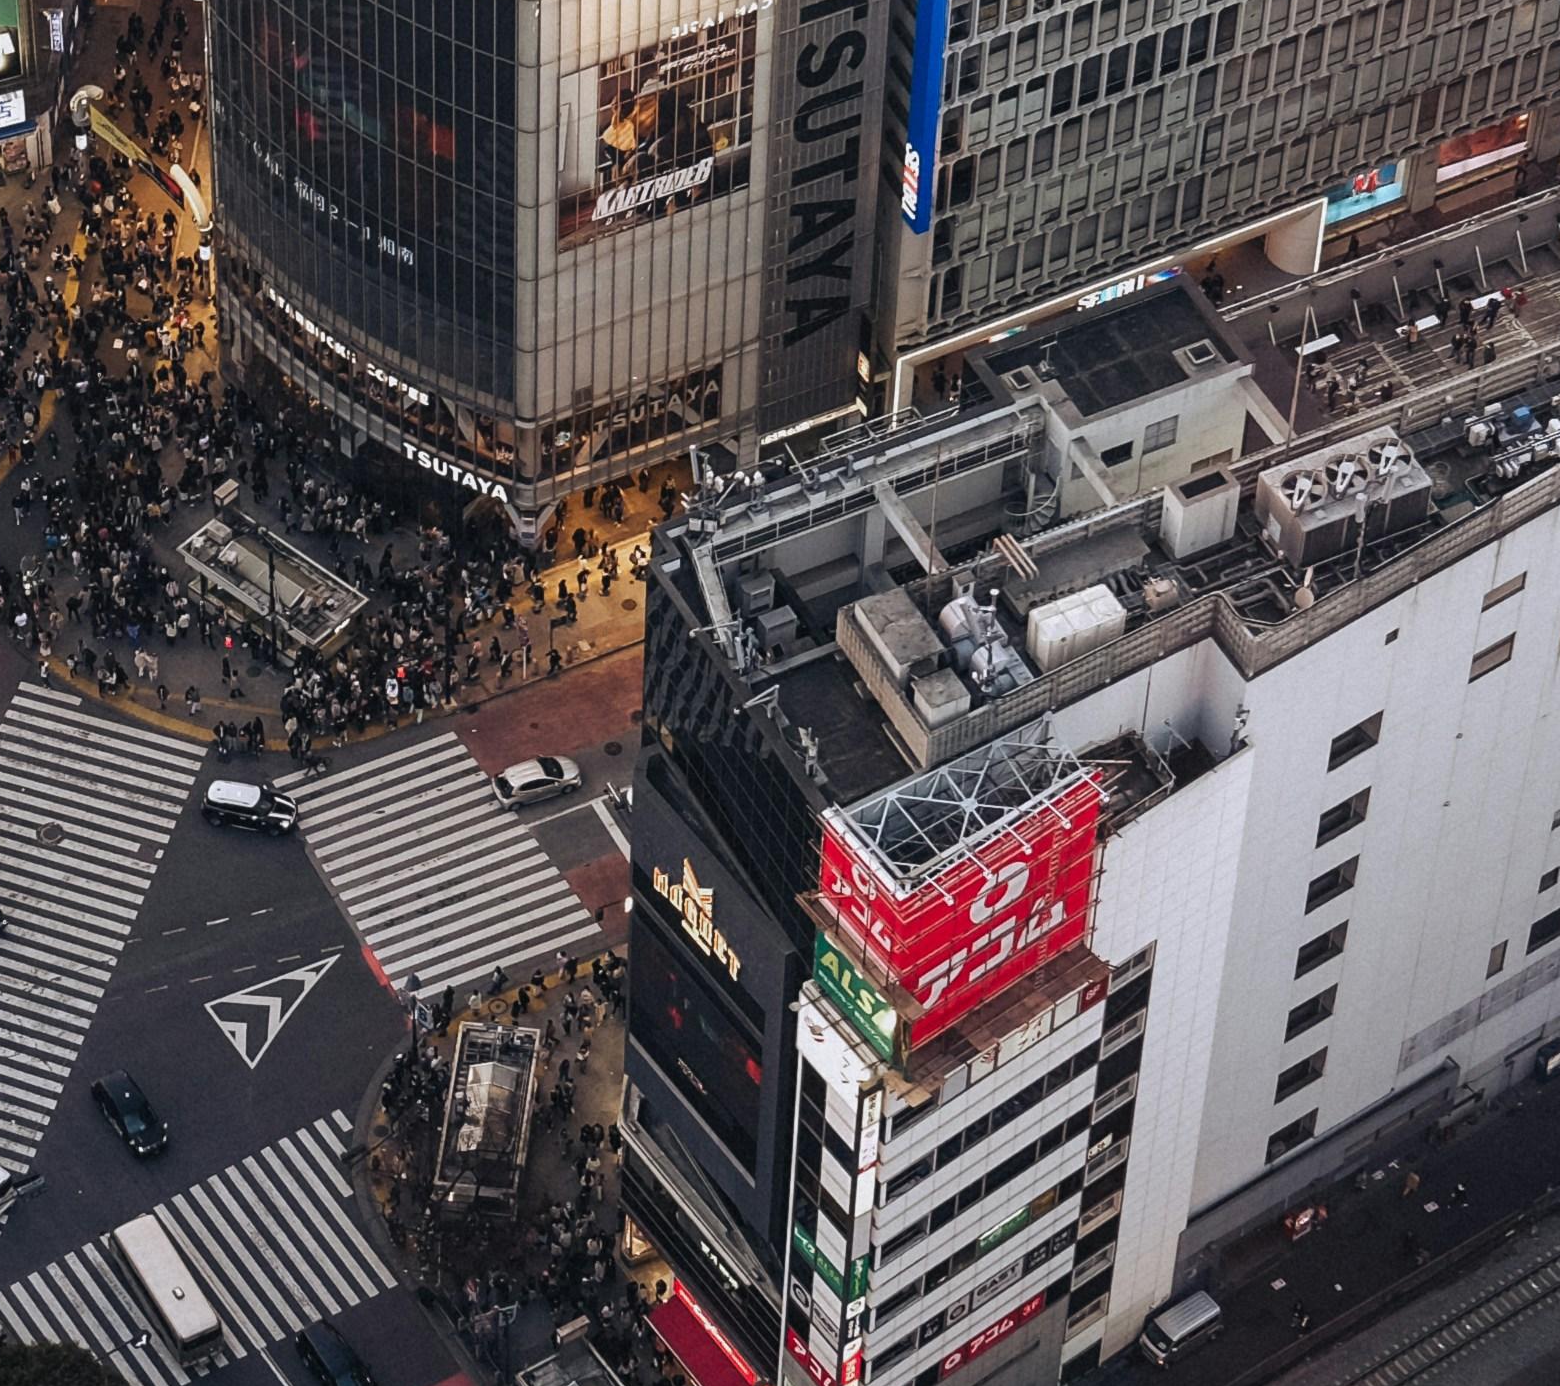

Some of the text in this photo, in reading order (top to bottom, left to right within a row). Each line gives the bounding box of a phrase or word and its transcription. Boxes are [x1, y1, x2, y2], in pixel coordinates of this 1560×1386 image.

[591, 156, 715, 222] KARTRIDER
[584, 379, 720, 434] TSUTAYA
[403, 442, 508, 504] TSUTAYA
[914, 900, 1067, 1011] アコム
[969, 1316, 1014, 1356] アコム
